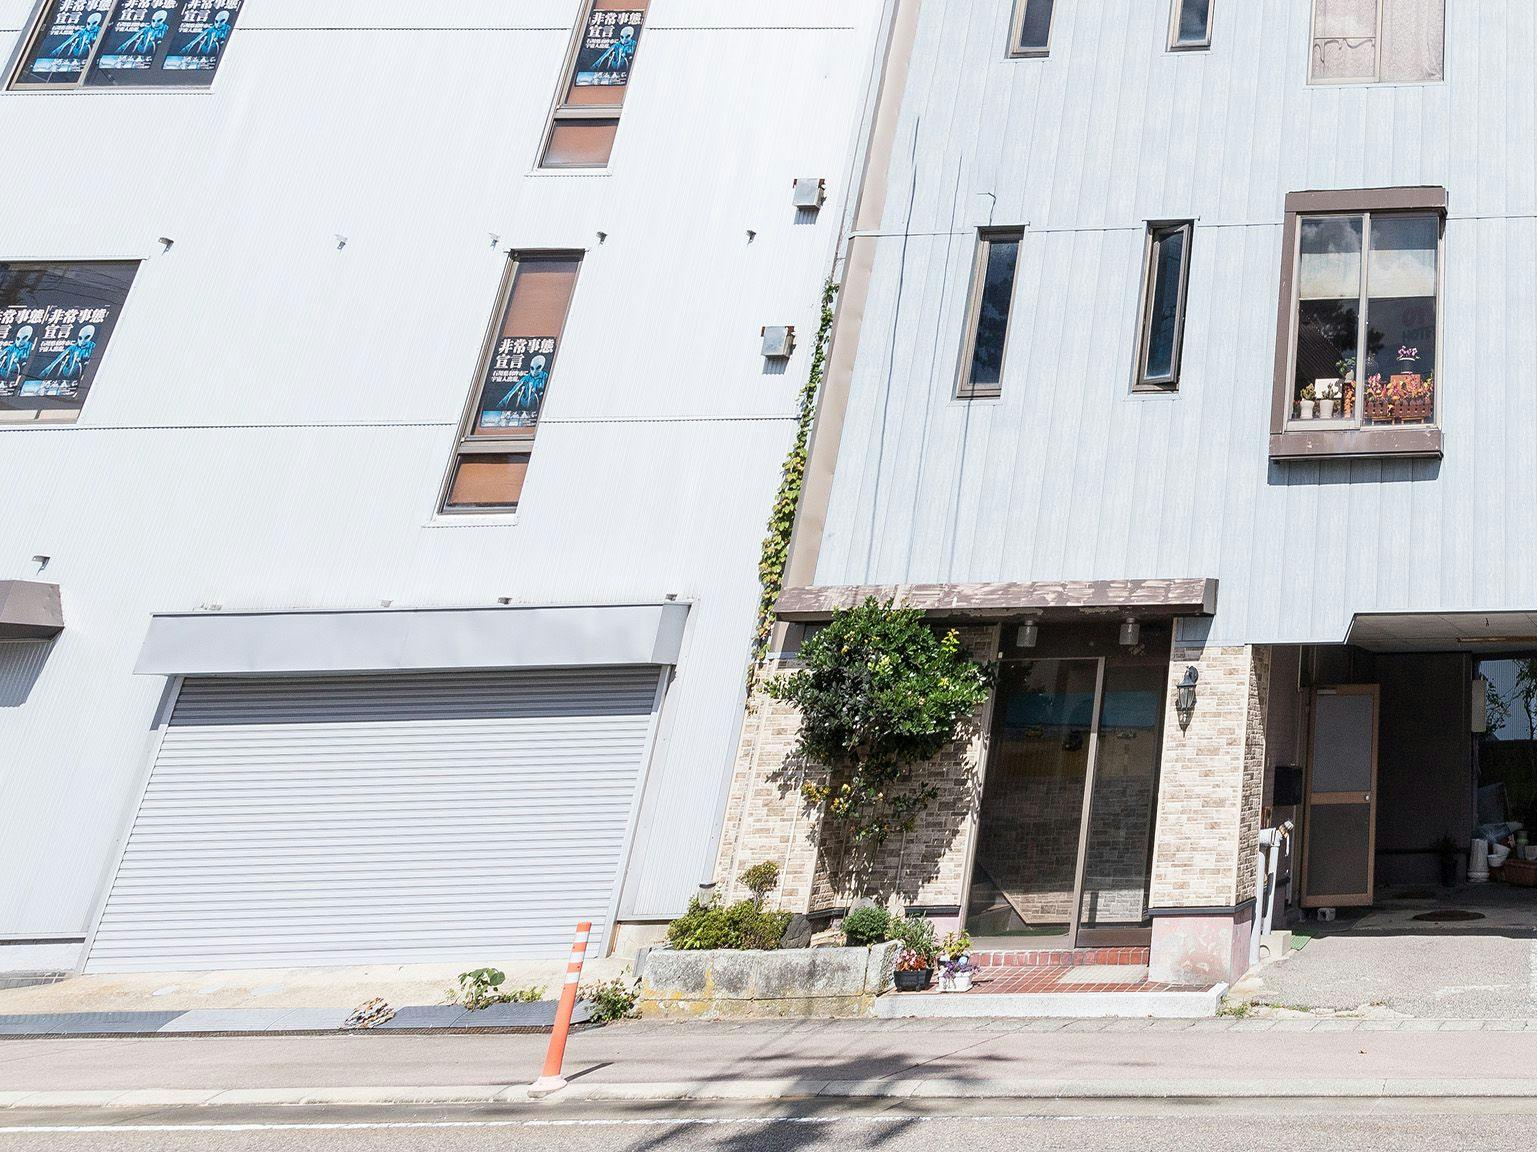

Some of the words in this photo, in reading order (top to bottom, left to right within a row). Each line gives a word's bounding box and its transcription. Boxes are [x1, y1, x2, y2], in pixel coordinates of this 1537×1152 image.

[591, 12, 641, 25] 非常事態
[587, 25, 615, 38] 宣言
[0, 309, 45, 324] 常事態
[48, 308, 107, 324] 非常事態
[43, 324, 74, 339] 宣言
[498, 338, 555, 354] 非常事態
[494, 354, 525, 369] 宣言
